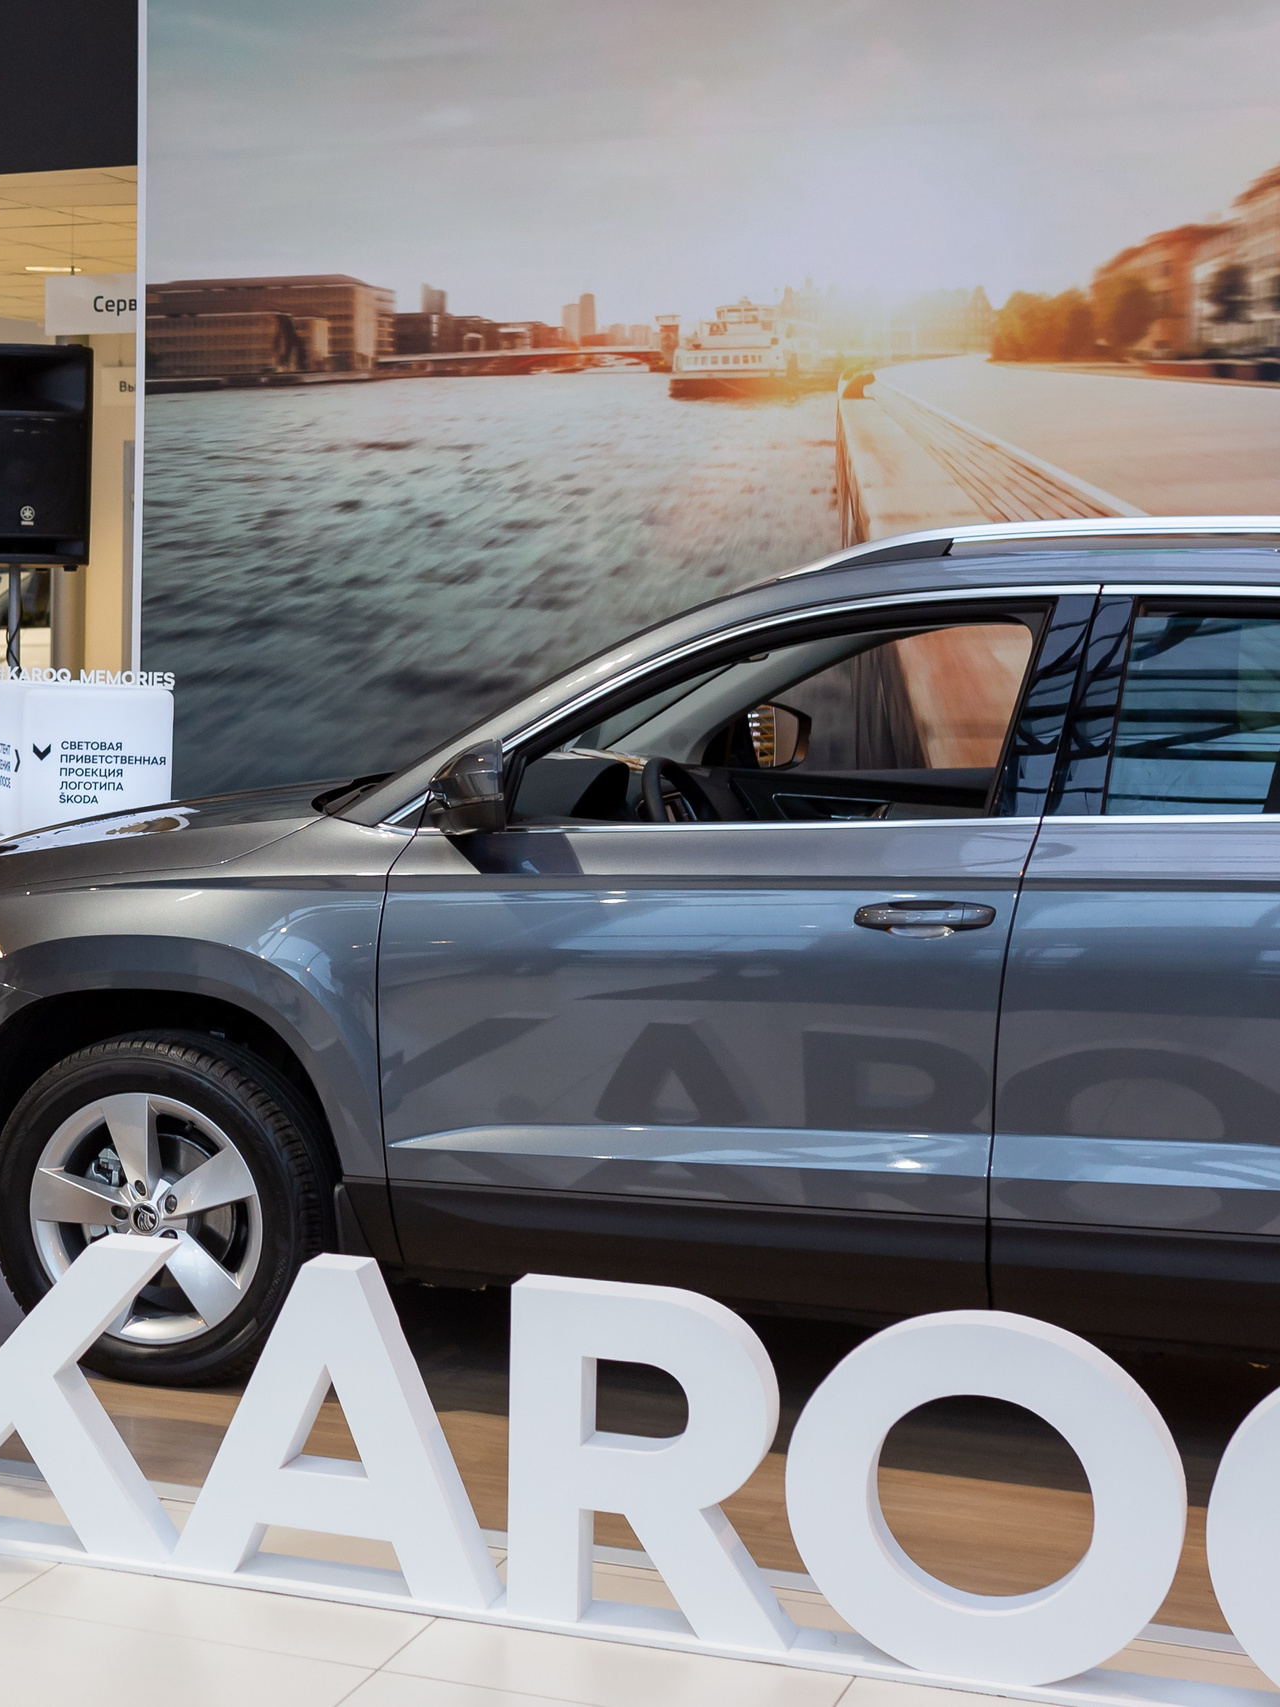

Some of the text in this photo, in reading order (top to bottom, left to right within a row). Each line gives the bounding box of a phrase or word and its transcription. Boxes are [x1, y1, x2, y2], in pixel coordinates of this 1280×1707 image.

[93, 295, 137, 316] Серв
[61, 741, 123, 751] СВЕТОВАЯ
[60, 754, 167, 766] ПРИВЕТСТВЕННАЯ
[59, 768, 123, 779] ПРОЕКЦИЯ
[59, 781, 124, 791] ЛОГОТИПА
[59, 792, 99, 804] ŠKODA
